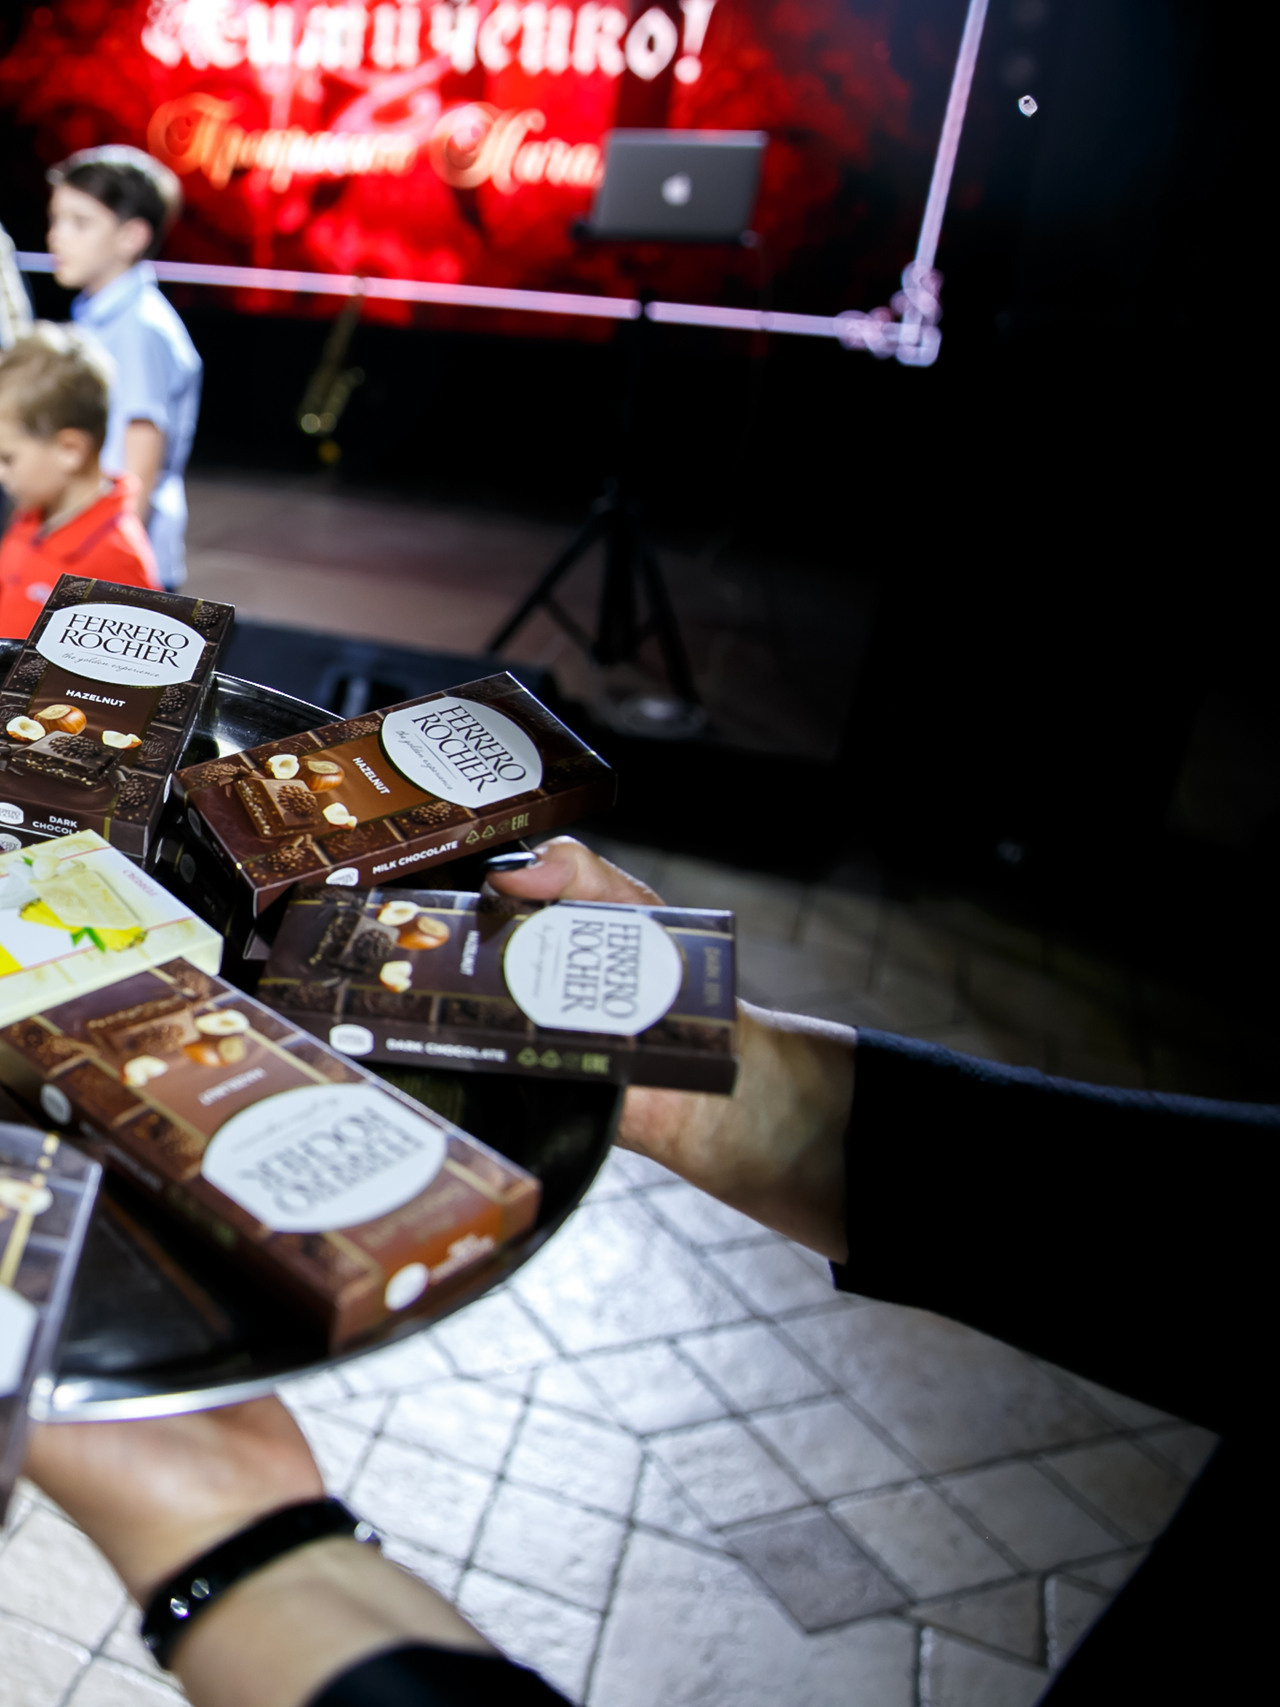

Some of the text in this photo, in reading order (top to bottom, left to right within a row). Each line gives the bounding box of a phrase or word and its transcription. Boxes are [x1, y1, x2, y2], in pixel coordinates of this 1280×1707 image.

[59, 629, 181, 668] ROCHER
[66, 613, 190, 650] FERRERO
[65, 689, 127, 708] HAZELNUT
[411, 712, 498, 794] ROCHER
[438, 705, 527, 782] FERRERO
[352, 757, 391, 795] HAZELNUT
[49, 816, 78, 828] DARK
[372, 840, 459, 875] MILK CHOCOLATE
[561, 919, 605, 1014] ROCHER
[601, 922, 642, 1019] FERRERO
